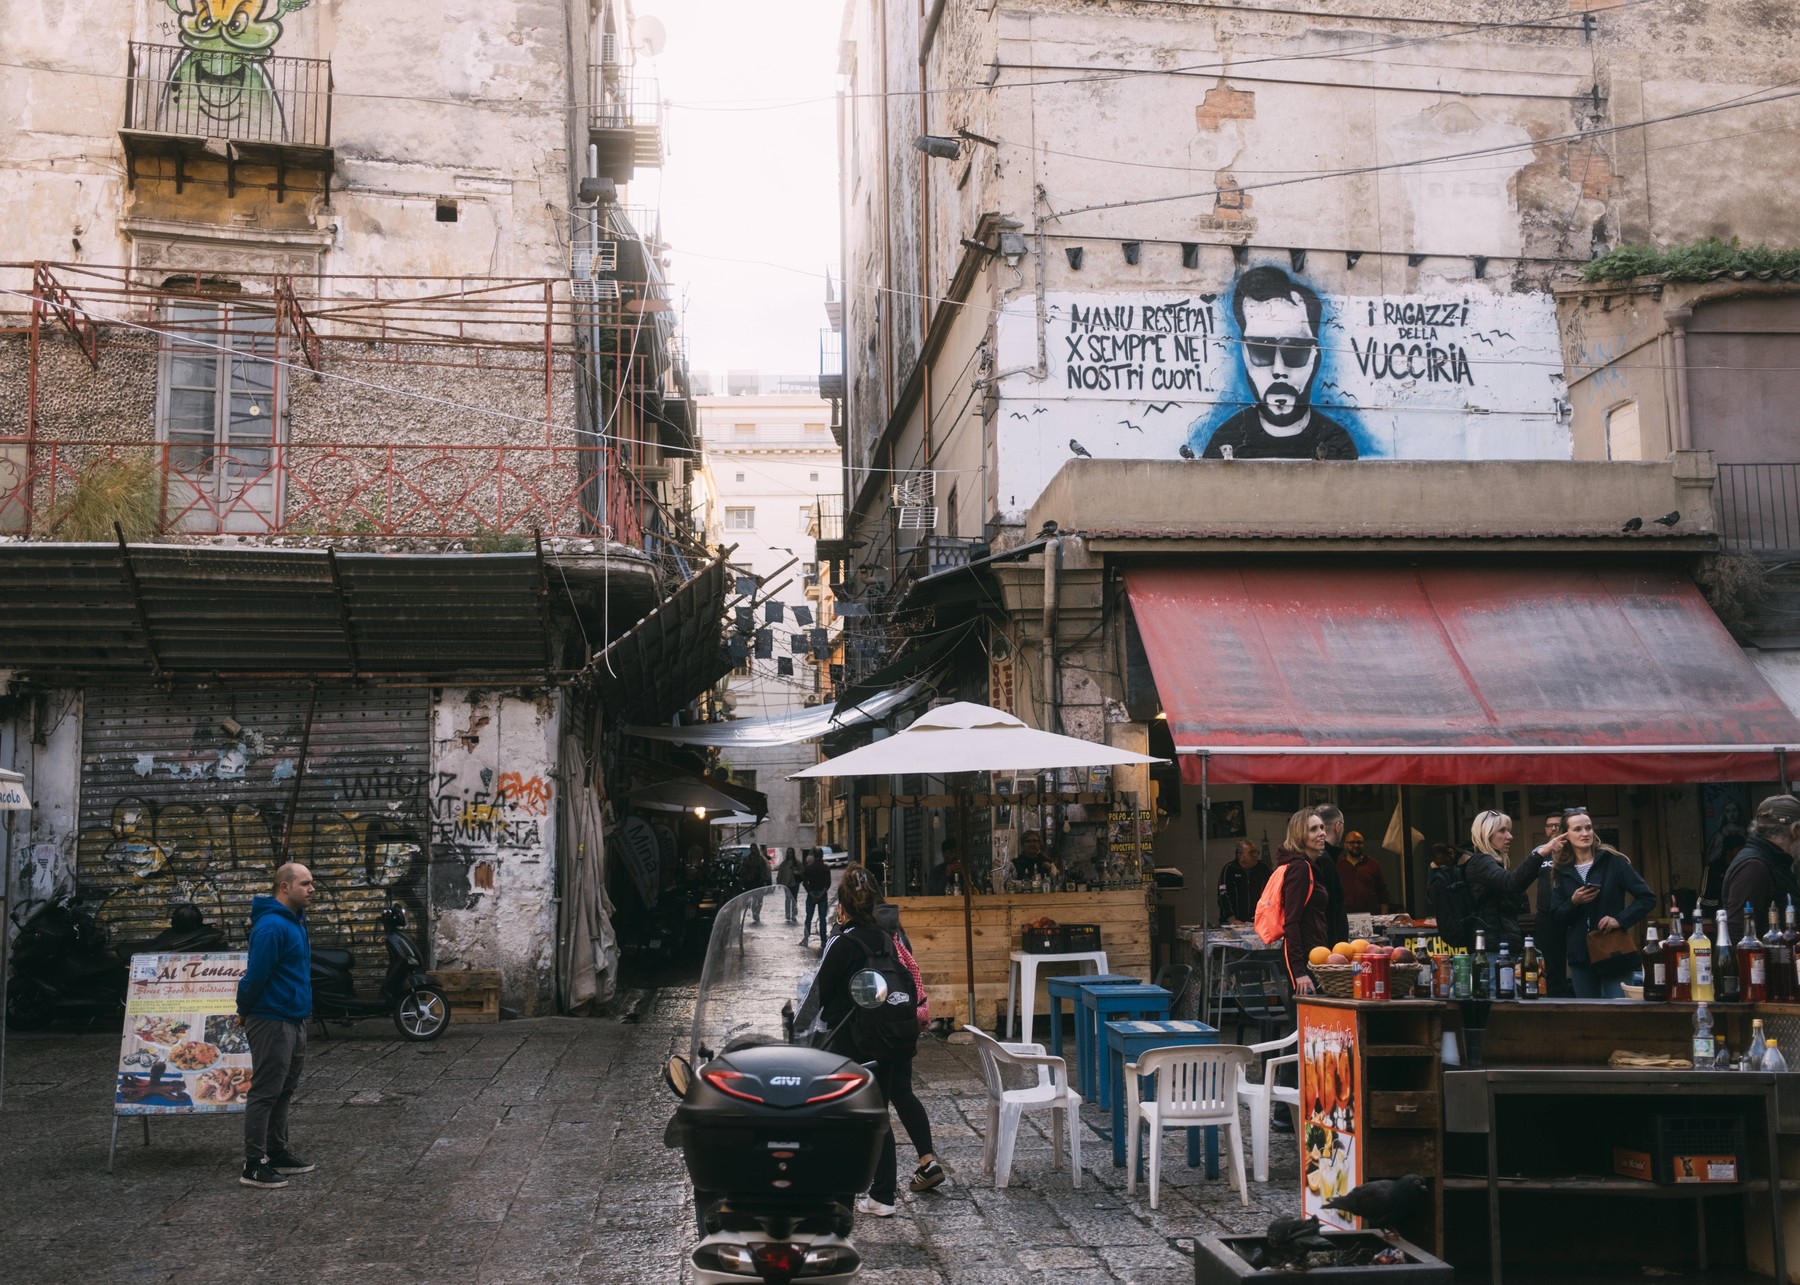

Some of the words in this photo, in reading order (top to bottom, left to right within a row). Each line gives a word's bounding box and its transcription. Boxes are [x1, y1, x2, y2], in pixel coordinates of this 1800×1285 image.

[1071, 303, 1133, 334] MANU
[1398, 327, 1438, 341] DELLA
[1065, 334, 1084, 363] X
[156, 966, 178, 986] Al
[134, 986, 160, 995] Street
[162, 986, 184, 995] Food
[770, 1076, 801, 1086] GIVI
